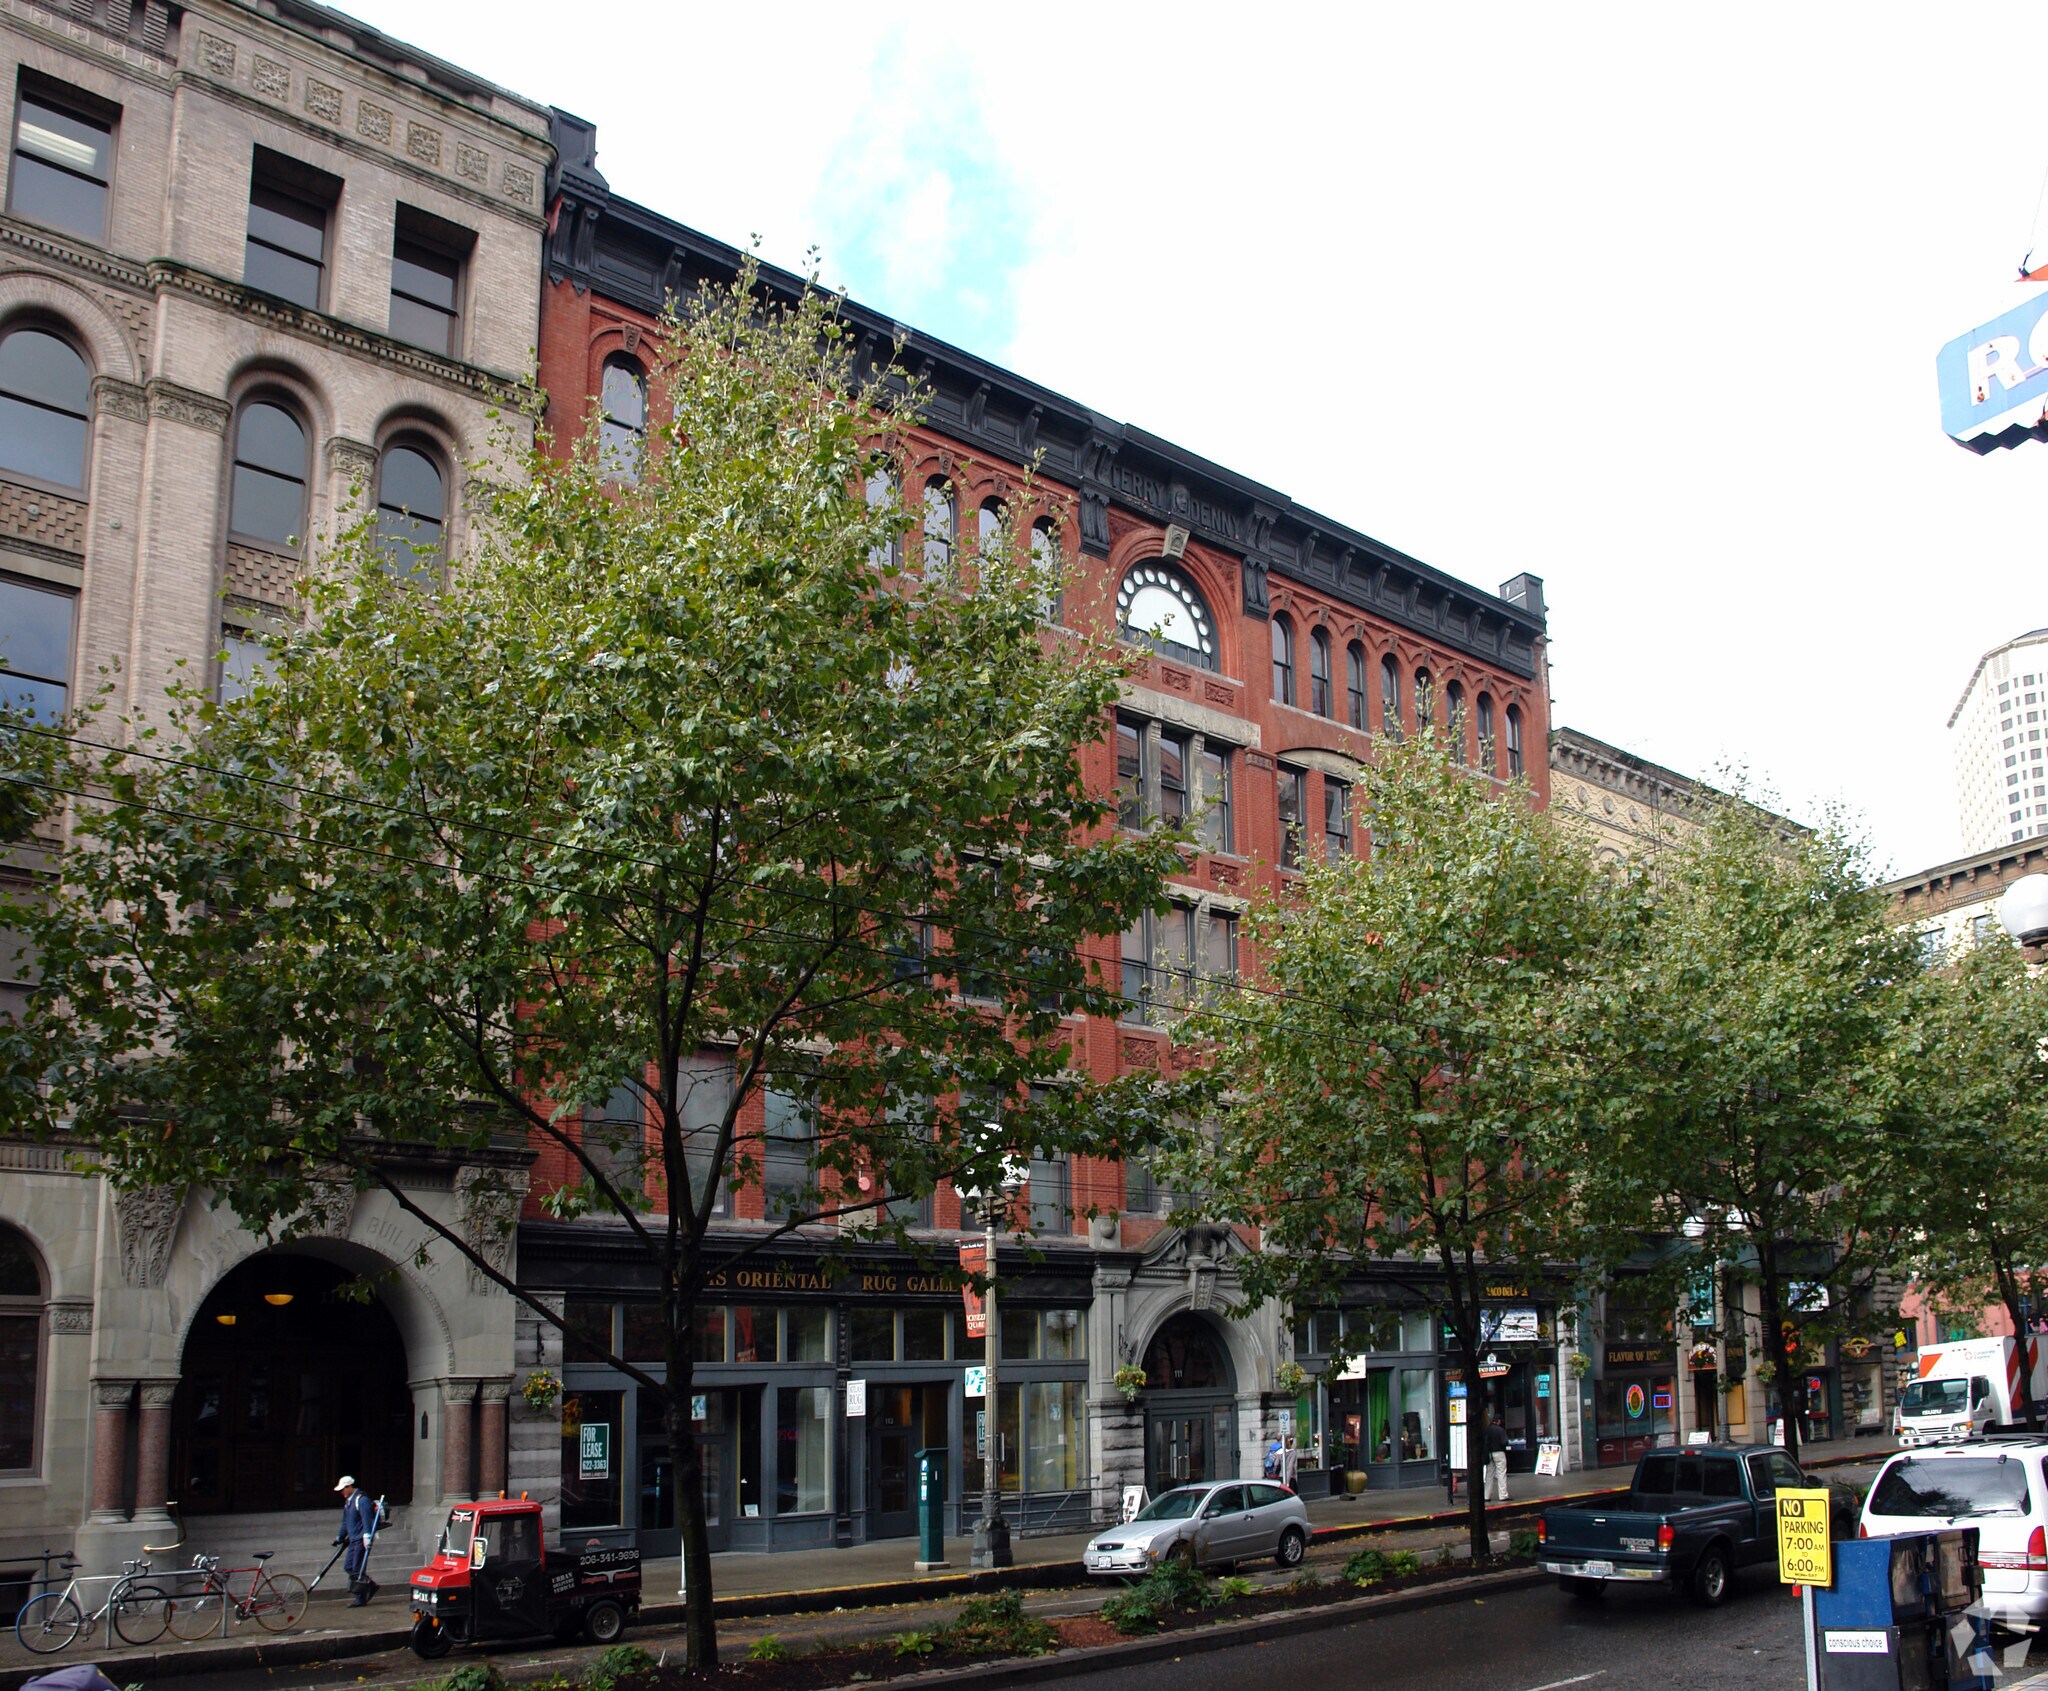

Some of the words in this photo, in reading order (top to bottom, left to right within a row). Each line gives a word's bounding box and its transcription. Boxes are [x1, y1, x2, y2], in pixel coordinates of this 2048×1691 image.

[1190, 497, 1242, 538] DENNY
[736, 1271, 831, 1290] ORIENTAL
[862, 1275, 897, 1292] RUG
[1608, 1351, 1635, 1362] FLAVOR
[1635, 1350, 1645, 1361] OF
[849, 1394, 862, 1405] RUG
[583, 1427, 596, 1442] FOR
[583, 1442, 603, 1458] LEASE
[1783, 1500, 1802, 1517] NO
[1784, 1520, 1825, 1535] PARKING
[1619, 1536, 1655, 1548] mazda
[1786, 1537, 1813, 1551] 7:00
[1787, 1558, 1814, 1572] 6:00
[1814, 1565, 1826, 1573] PM
[551, 1571, 573, 1583] URBAN
[1829, 1636, 1861, 1648] conscious
[1862, 1636, 1883, 1648] choice
